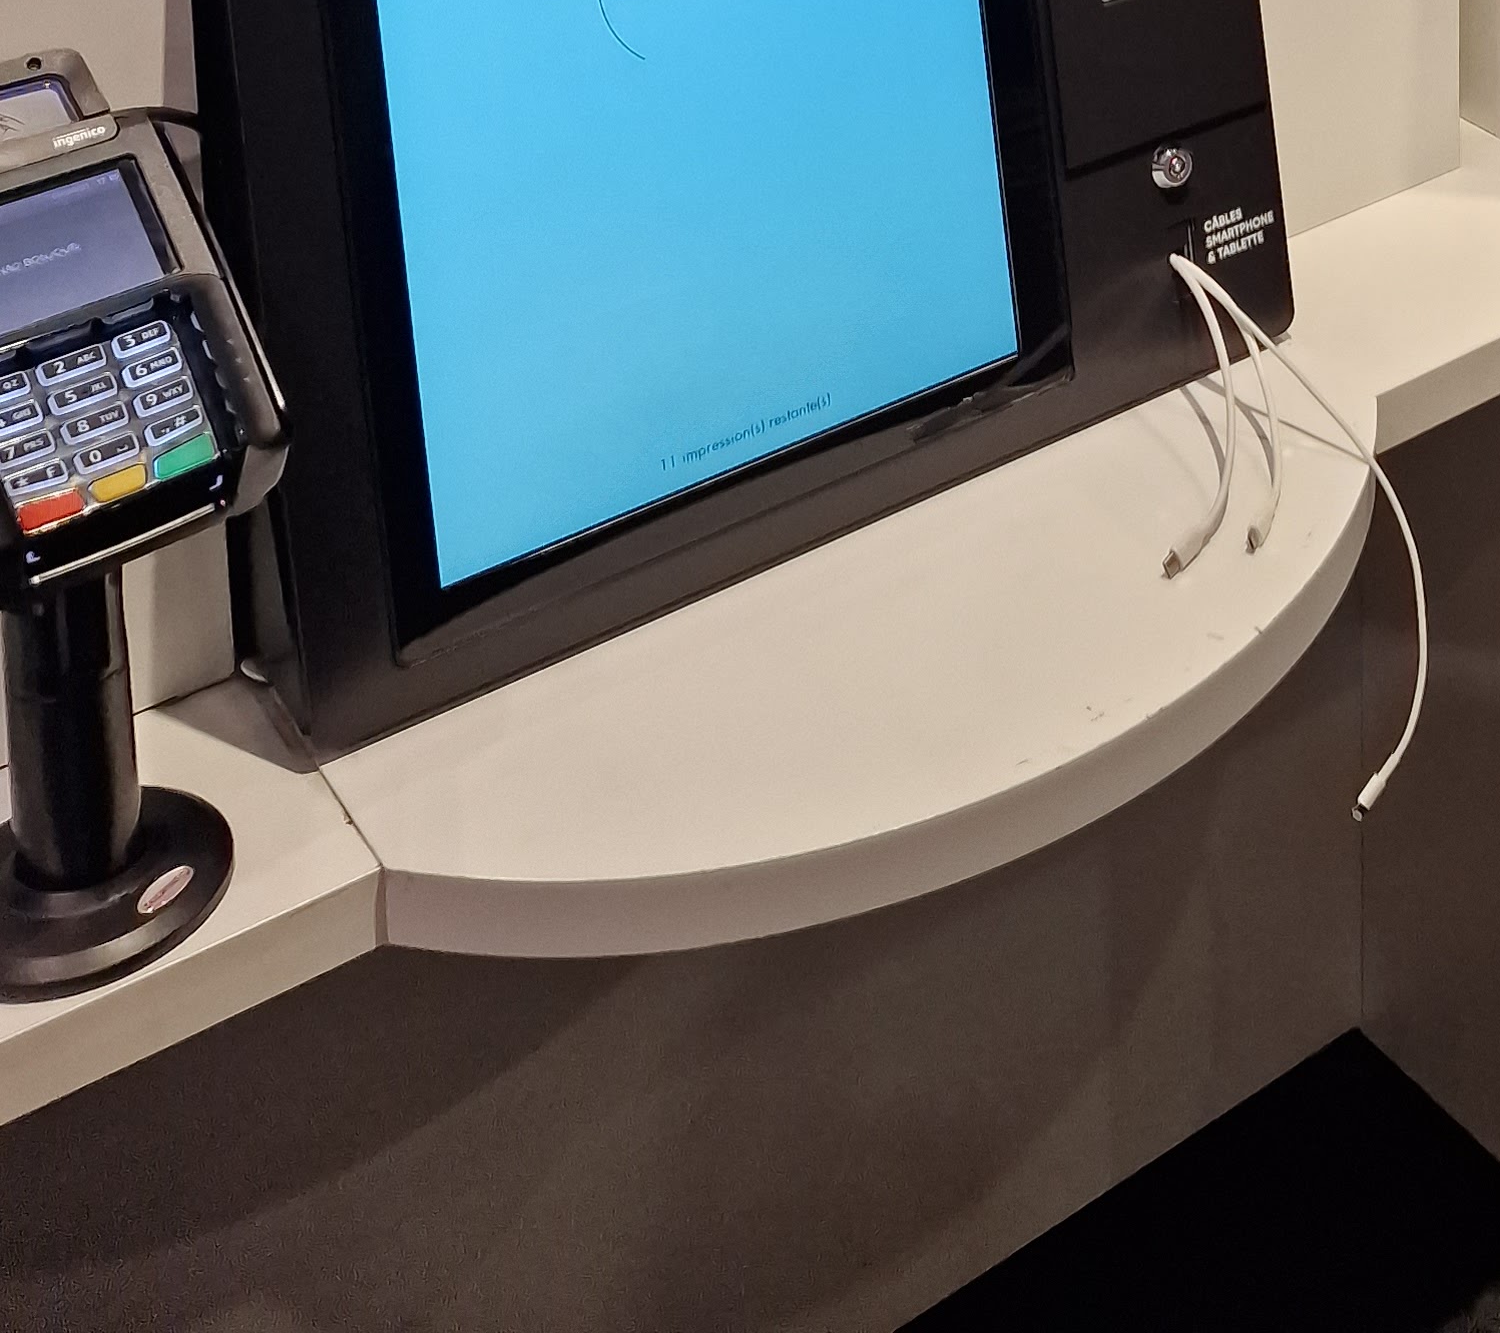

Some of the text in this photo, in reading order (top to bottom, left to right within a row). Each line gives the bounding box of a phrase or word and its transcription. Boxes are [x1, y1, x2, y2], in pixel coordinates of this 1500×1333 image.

[53, 125, 106, 149] ingenico
[1205, 209, 1275, 250] SMARTPHONE
[1216, 229, 1264, 261] TABLETTE
[124, 335, 135, 347] 3
[53, 352, 97, 374] 2 ABC
[135, 364, 148, 376] 6
[3, 378, 19, 389] QZ
[64, 391, 78, 404] 5
[145, 393, 158, 405] 9
[76, 409, 119, 433] 8 TUV
[682, 419, 766, 464] impression(s)
[769, 392, 832, 429] restante(s)
[3, 447, 15, 460] 7
[89, 450, 102, 463] 0
[46, 466, 57, 478] F
